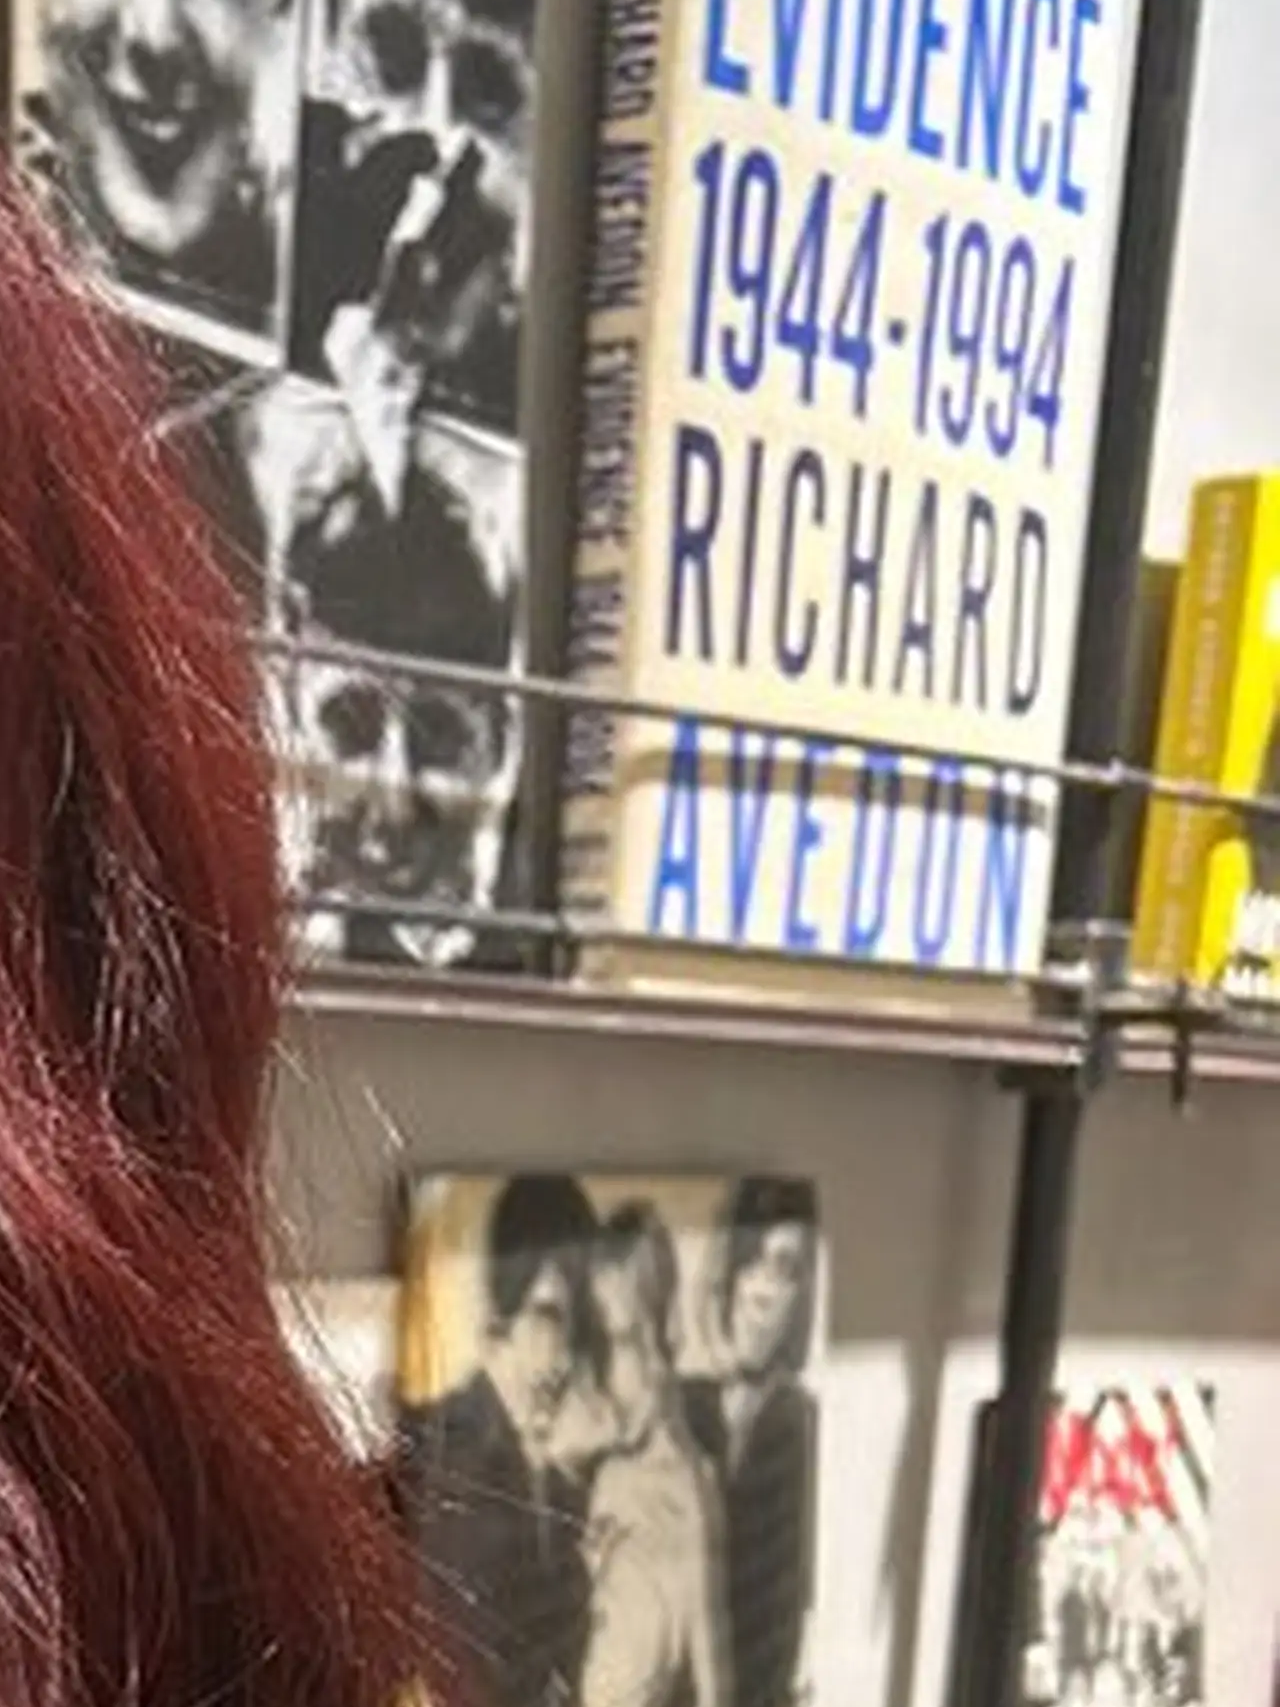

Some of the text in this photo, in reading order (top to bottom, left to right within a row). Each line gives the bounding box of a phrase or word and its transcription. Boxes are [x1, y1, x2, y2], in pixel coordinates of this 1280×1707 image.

[686, 142, 1077, 470] 1944-1994
[665, 426, 1049, 717] RICHARD
[647, 705, 1030, 975] AVEDON
